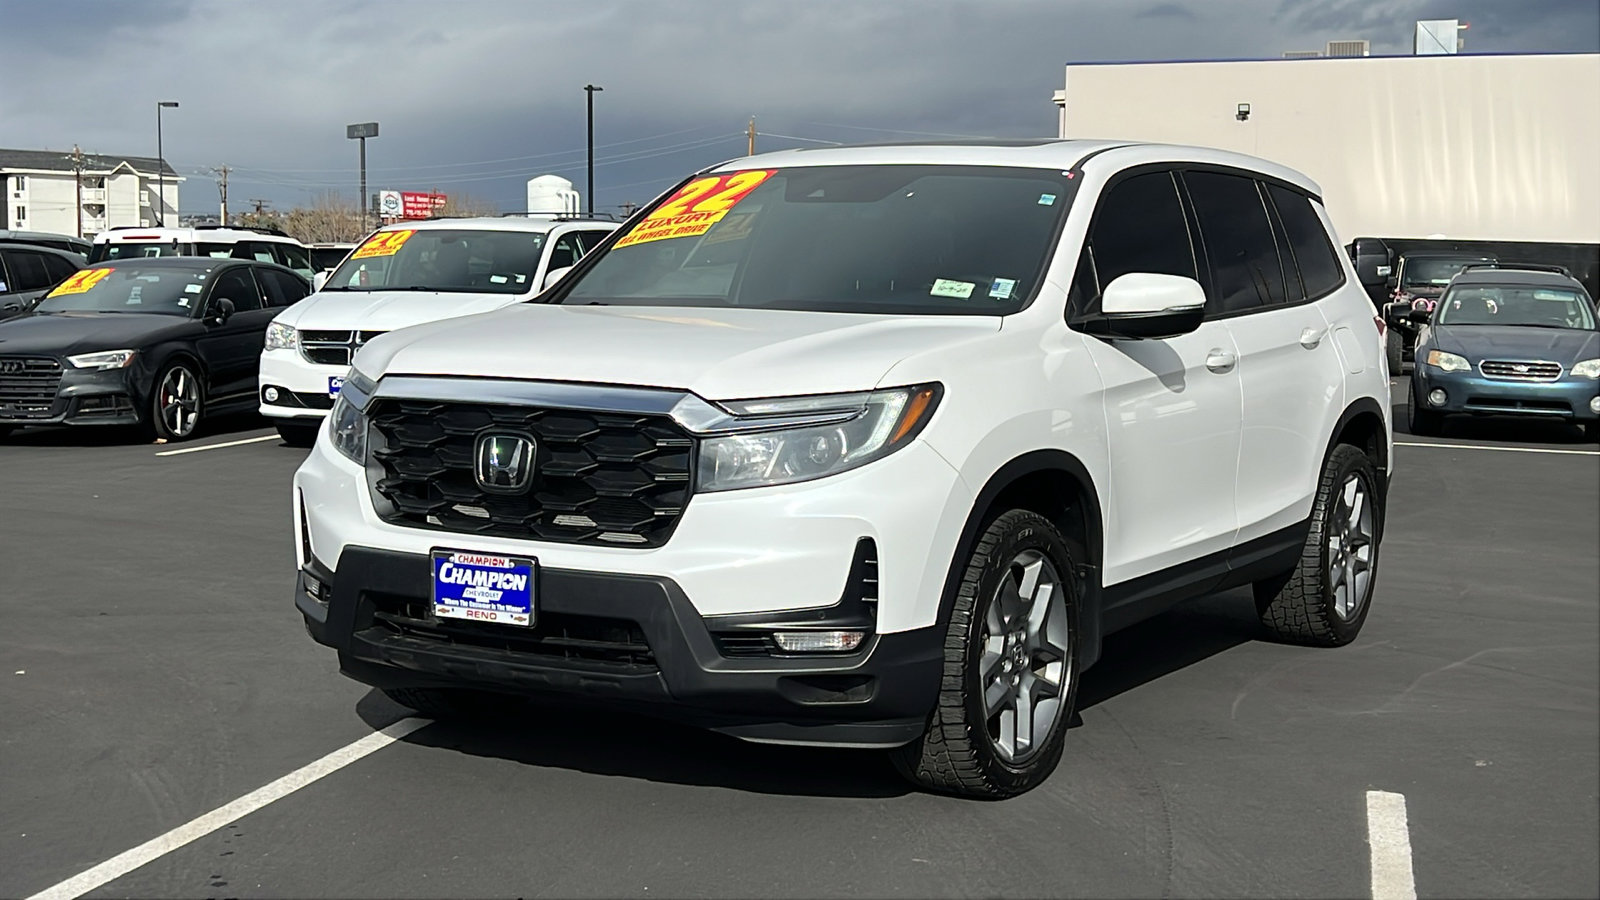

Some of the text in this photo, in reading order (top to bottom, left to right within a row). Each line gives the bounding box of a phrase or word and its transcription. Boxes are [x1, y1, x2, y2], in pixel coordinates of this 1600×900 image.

[646, 170, 768, 221] 22
[637, 211, 721, 232] LUXURY
[362, 230, 412, 248] 20
[637, 228, 673, 241] WHEEL
[673, 223, 709, 236] DRIVE
[458, 554, 505, 567] CHAMPION
[439, 562, 528, 592] CHAMPION
[465, 589, 500, 598] CHEVROLET
[466, 610, 497, 620] RENO
